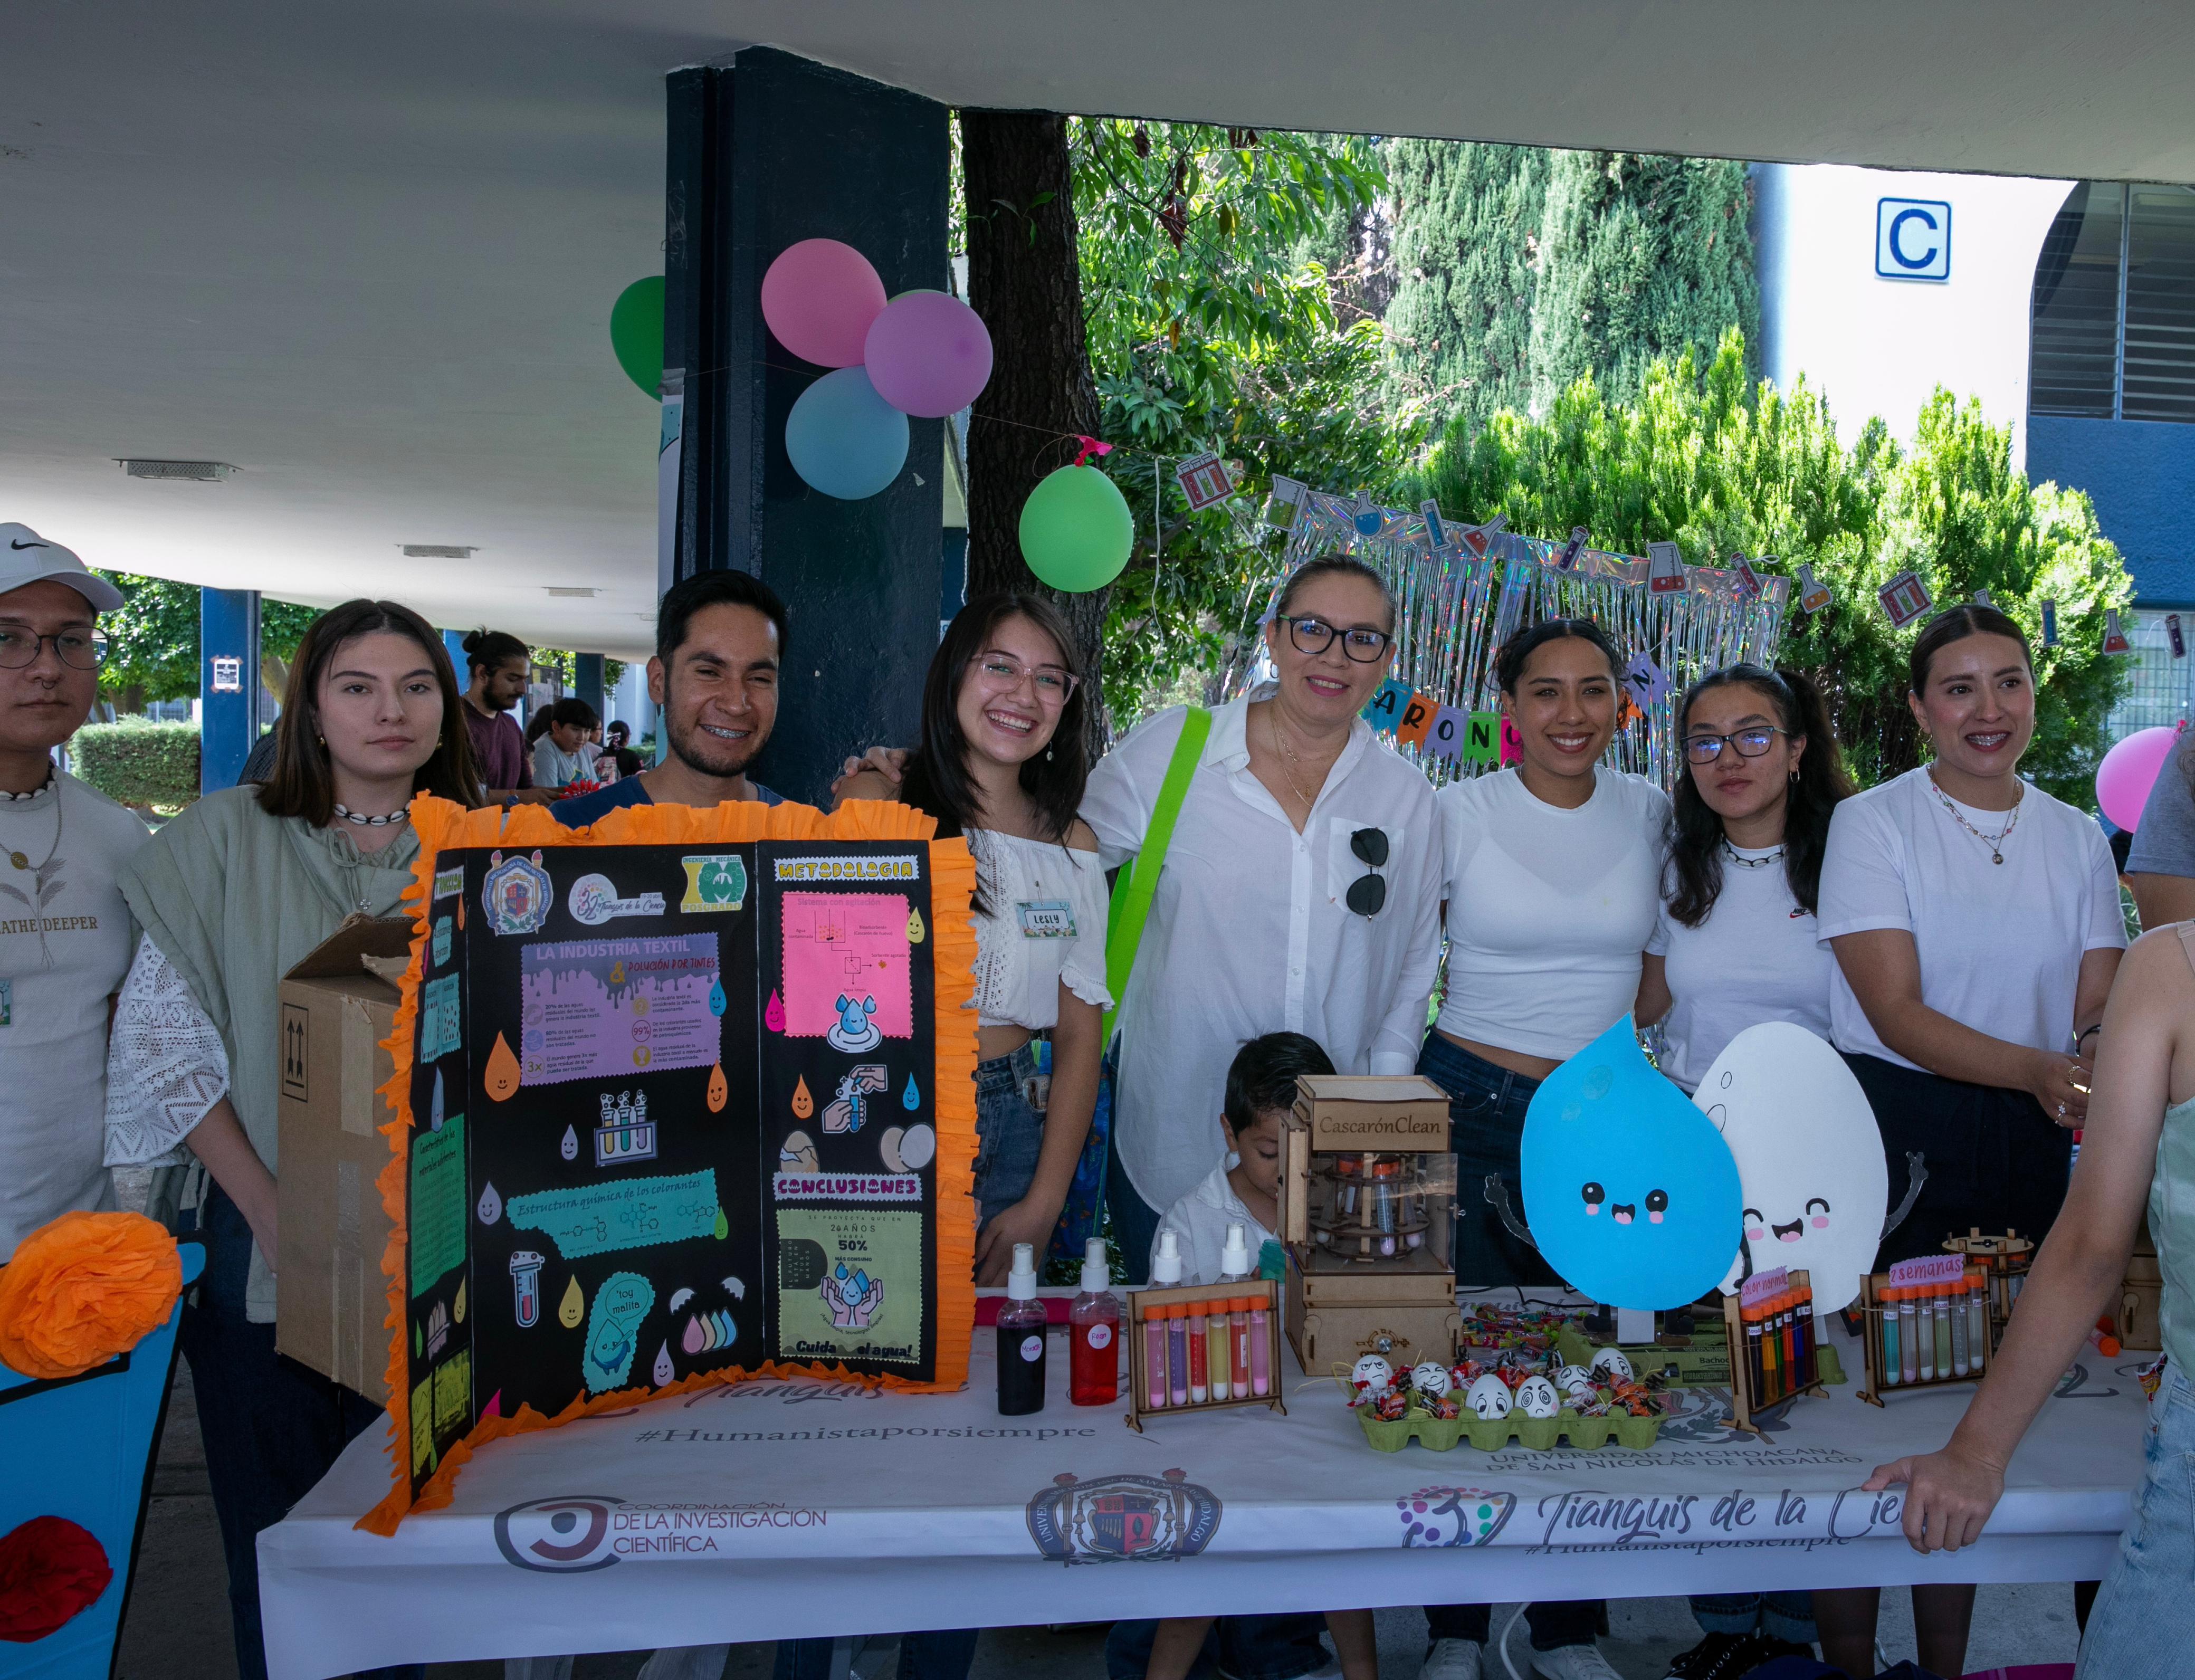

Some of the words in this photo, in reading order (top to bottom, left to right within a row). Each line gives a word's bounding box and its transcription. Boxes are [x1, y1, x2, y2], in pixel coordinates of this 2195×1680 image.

[1889, 209, 1938, 269] C
[682, 902, 740, 912] POSGRADO
[846, 899, 880, 907] agitación
[0, 919, 37, 934] ATHE
[42, 917, 98, 932] DEEPER
[536, 947, 556, 960] LA
[560, 942, 640, 959] INDUSTRIA
[643, 939, 691, 953] TEXTIL
[610, 961, 625, 983] &
[628, 959, 670, 972] POLUCIÓN
[672, 959, 690, 970] POR
[691, 957, 715, 969] TINTES
[633, 1026, 650, 1035] 99%
[527, 1061, 542, 1073] 3x
[1320, 1115, 1441, 1133] CascarónClean
[778, 1179, 917, 1194] CONCLUSIONES
[518, 1199, 578, 1216] Estructura
[581, 1192, 623, 1210] química
[624, 1188, 635, 1201] de
[637, 1184, 651, 1196] los
[652, 1179, 701, 1195] colorantes
[843, 1223, 876, 1232] AÑOS
[794, 1246, 798, 1256] EN
[838, 1240, 868, 1251] 50%
[1891, 1269, 1896, 1283] 2
[1898, 1258, 1961, 1280] semanas
[612, 1301, 640, 1314] malita
[796, 1340, 836, 1353] Cuida
[857, 1342, 871, 1355] el
[872, 1344, 913, 1358] agua!
[635, 1426, 1096, 1443] #Humanistaporsiempre
[1489, 1452, 1662, 1463] UNIVERSIDAD
[1671, 1448, 1847, 1458] MICHOACANA
[1527, 1463, 1576, 1471] SAN
[1585, 1458, 1697, 1470] NICOLÁS
[1741, 1456, 1864, 1466] HIDALGO
[617, 1501, 786, 1511] COORDINACIÓN
[614, 1513, 641, 1530] DE
[645, 1513, 669, 1529] LA
[674, 1507, 827, 1529] INVESTIGACIÓN
[1537, 1490, 1699, 1545] Tianguis
[1710, 1489, 1756, 1532] de
[1775, 1488, 1807, 1526] la
[614, 1532, 718, 1553] CIENTÍFICA
